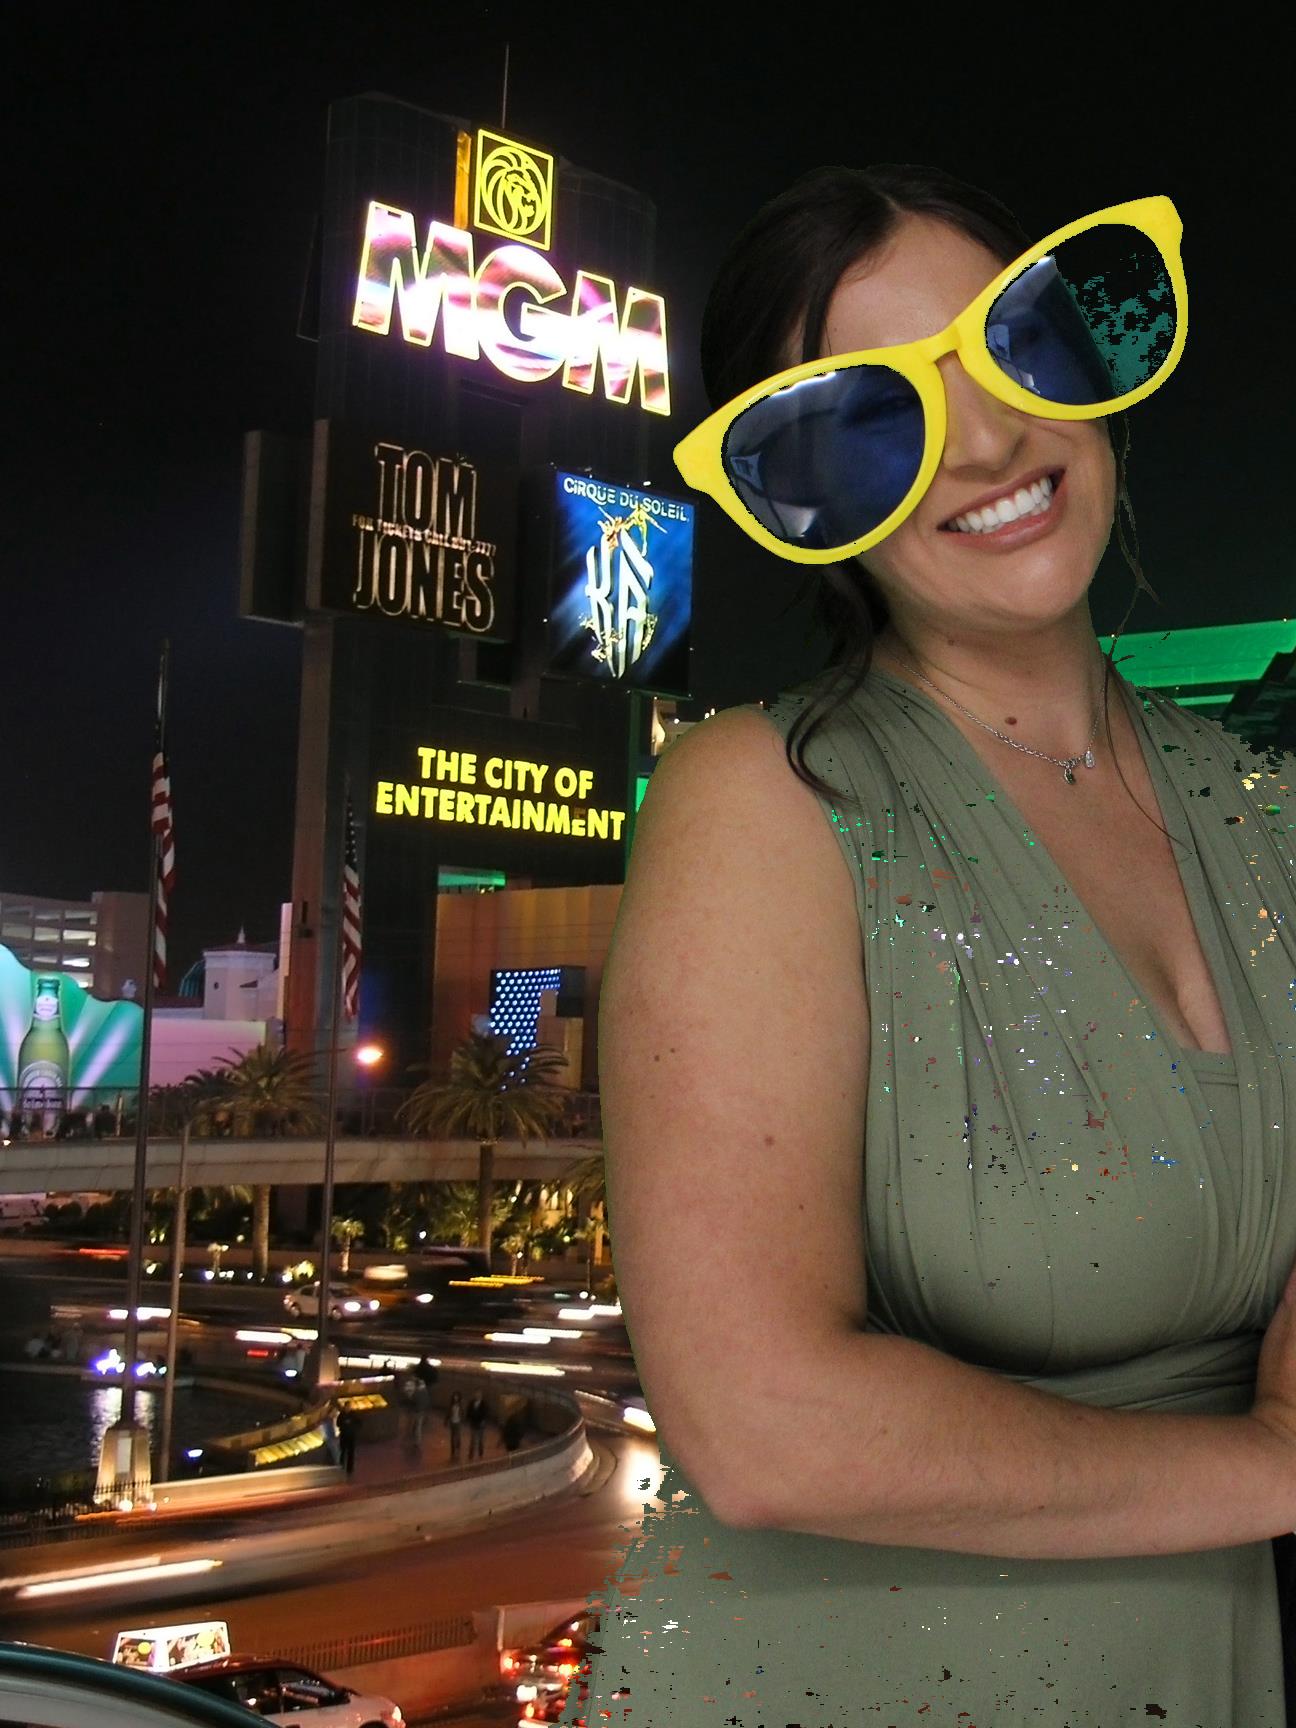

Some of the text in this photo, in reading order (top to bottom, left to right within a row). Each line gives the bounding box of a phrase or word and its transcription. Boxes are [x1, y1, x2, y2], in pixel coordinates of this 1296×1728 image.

[352, 200, 672, 417] MGM
[374, 442, 477, 539] TOM
[563, 477, 688, 521] CIRQUE DU SOLEIL
[352, 530, 496, 632] JONES
[376, 781, 626, 840] ENTERTAINMENT
[417, 747, 594, 799] THE CITY OF
